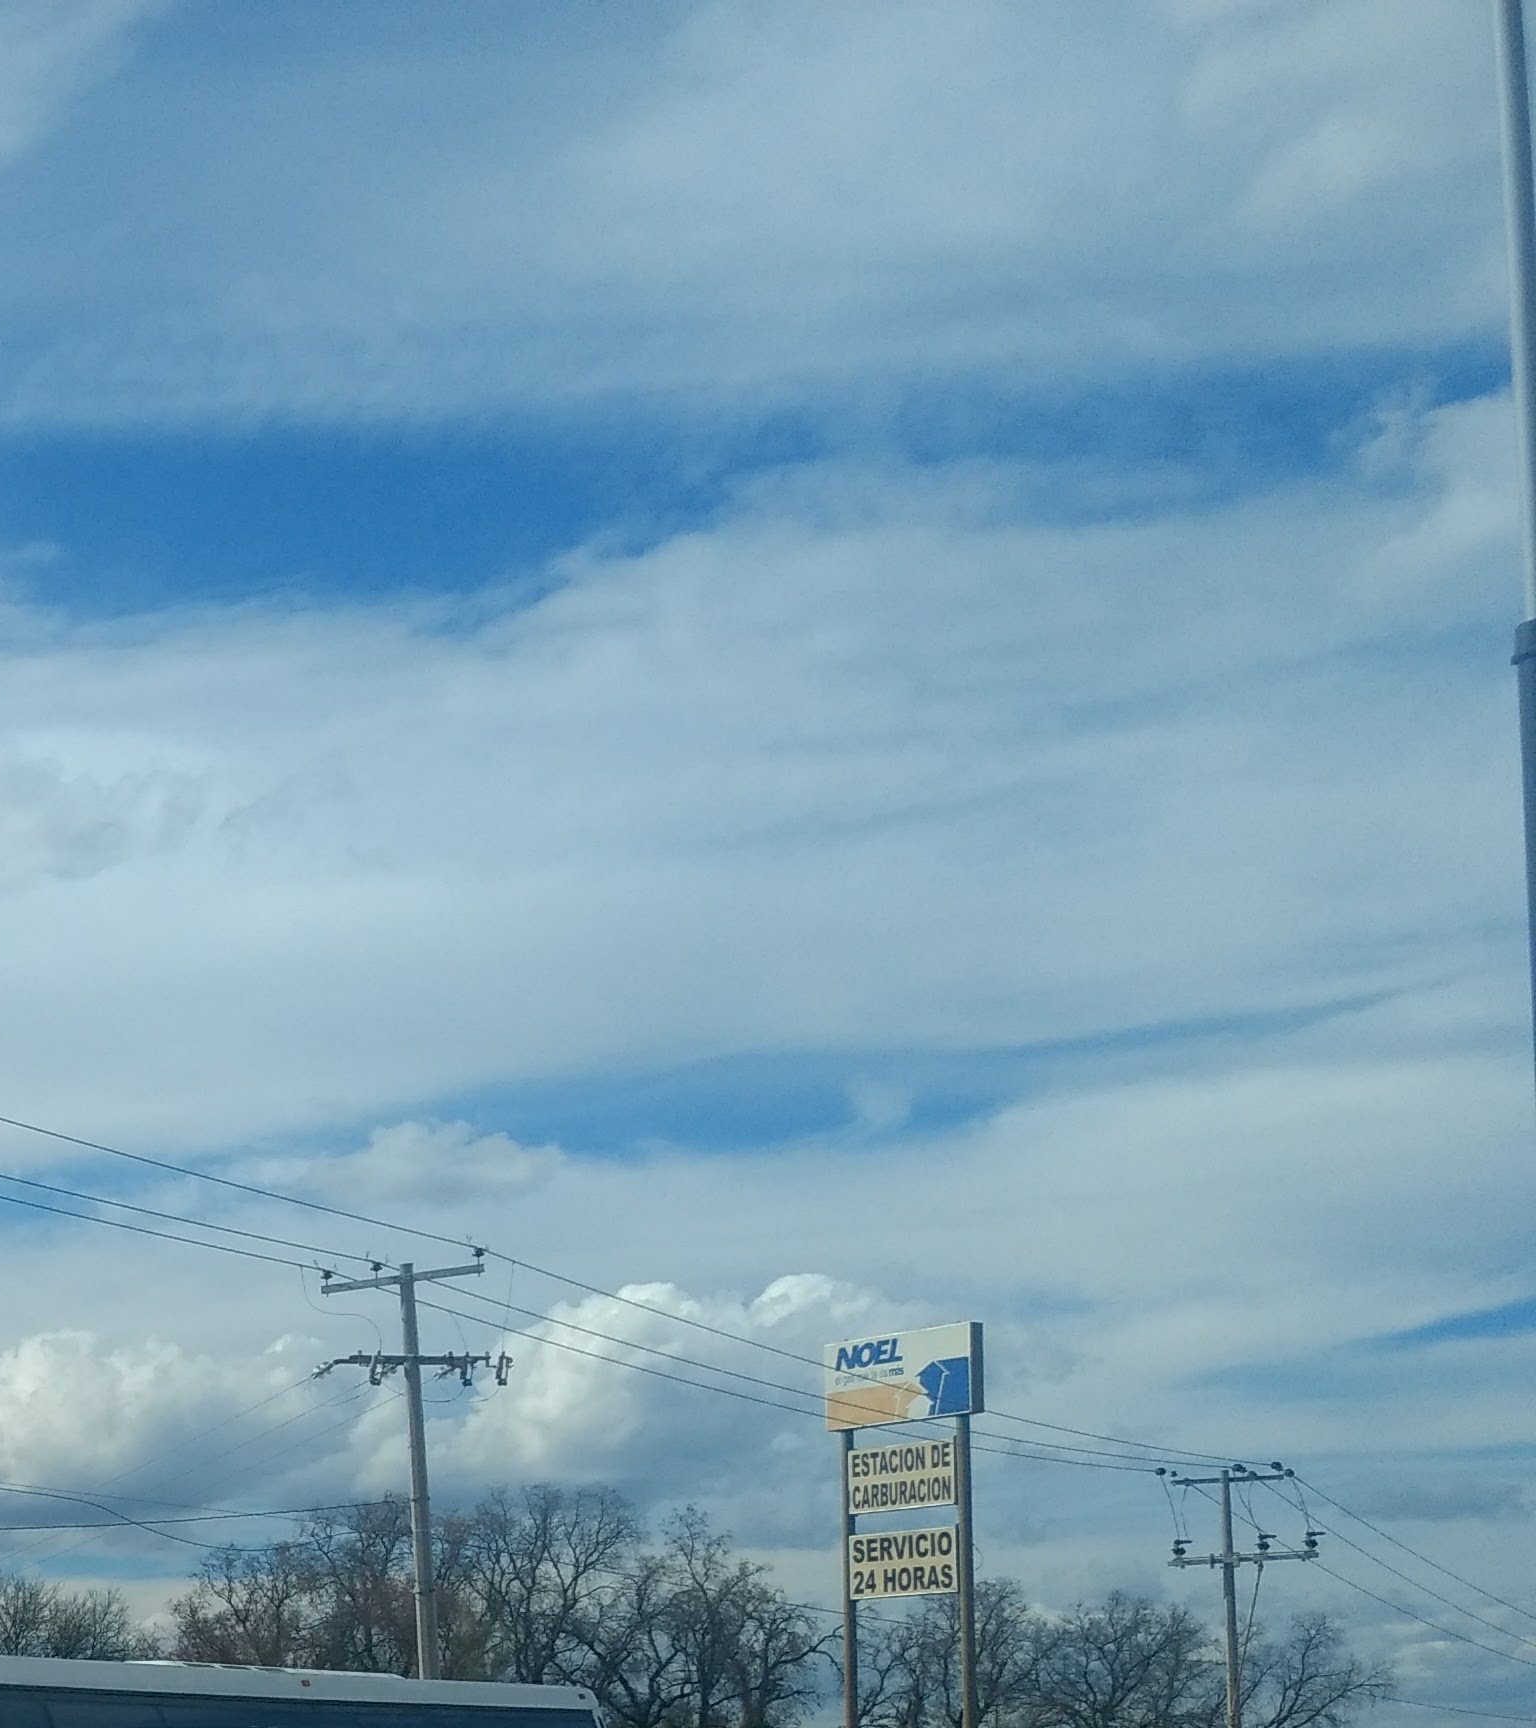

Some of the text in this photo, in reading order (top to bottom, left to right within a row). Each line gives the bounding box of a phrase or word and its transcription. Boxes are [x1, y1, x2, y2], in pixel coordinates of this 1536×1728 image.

[835, 1338, 903, 1371] NOEL
[851, 1442, 951, 1478] ESTACION DE
[852, 1475, 952, 1509] CARBURACION
[852, 1530, 953, 1564] SERVICIO
[853, 1564, 953, 1595] 24 HORAS
